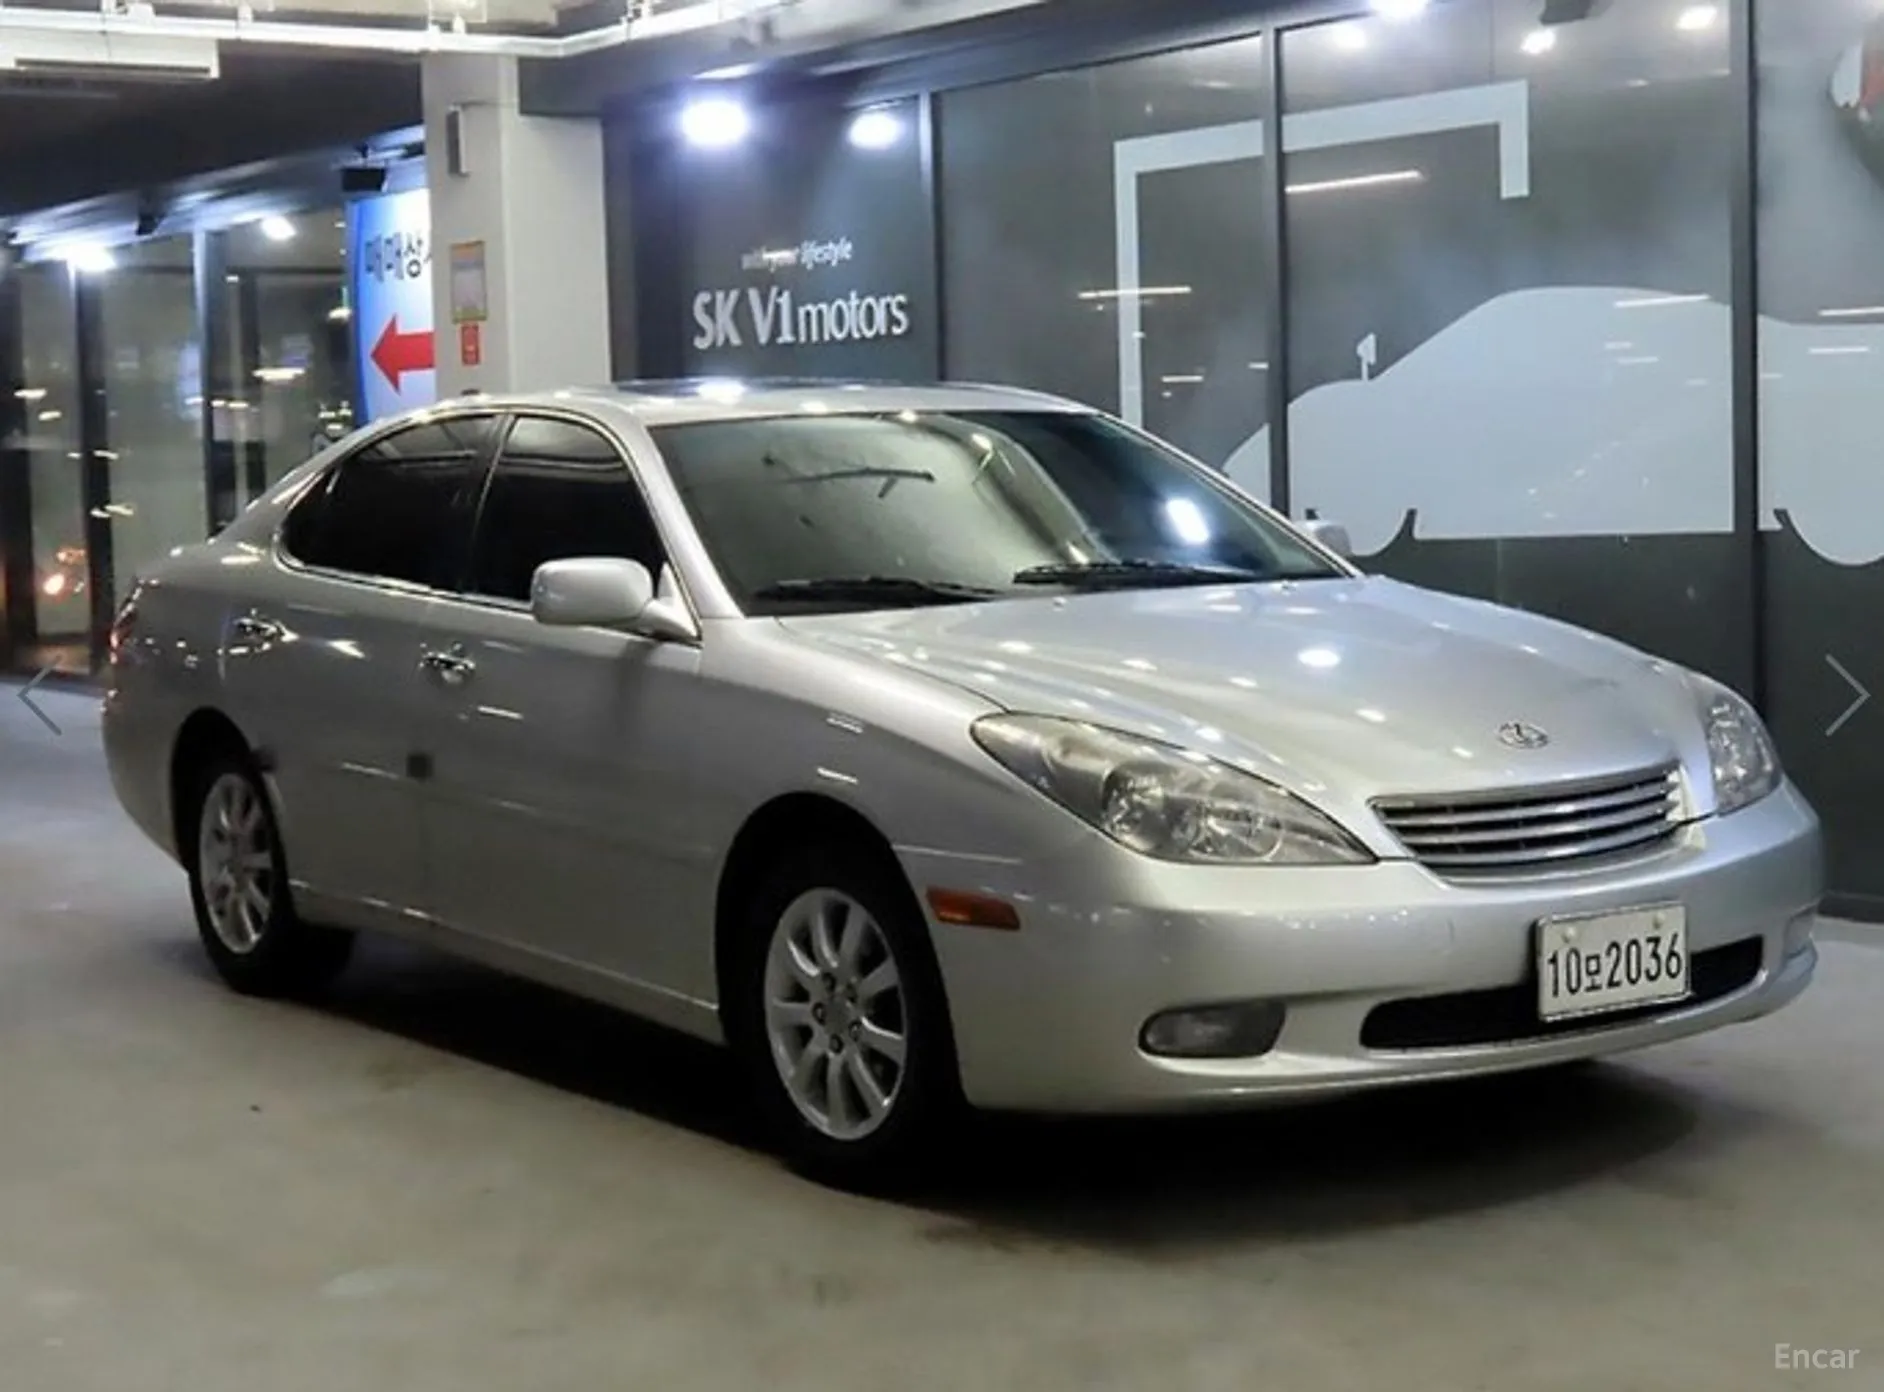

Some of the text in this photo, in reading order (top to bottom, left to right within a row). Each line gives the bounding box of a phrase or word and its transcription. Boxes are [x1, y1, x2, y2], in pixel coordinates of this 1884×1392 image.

[365, 231, 431, 283] 매매상
[693, 289, 742, 349] SK
[1548, 932, 1682, 998] 10모2036
